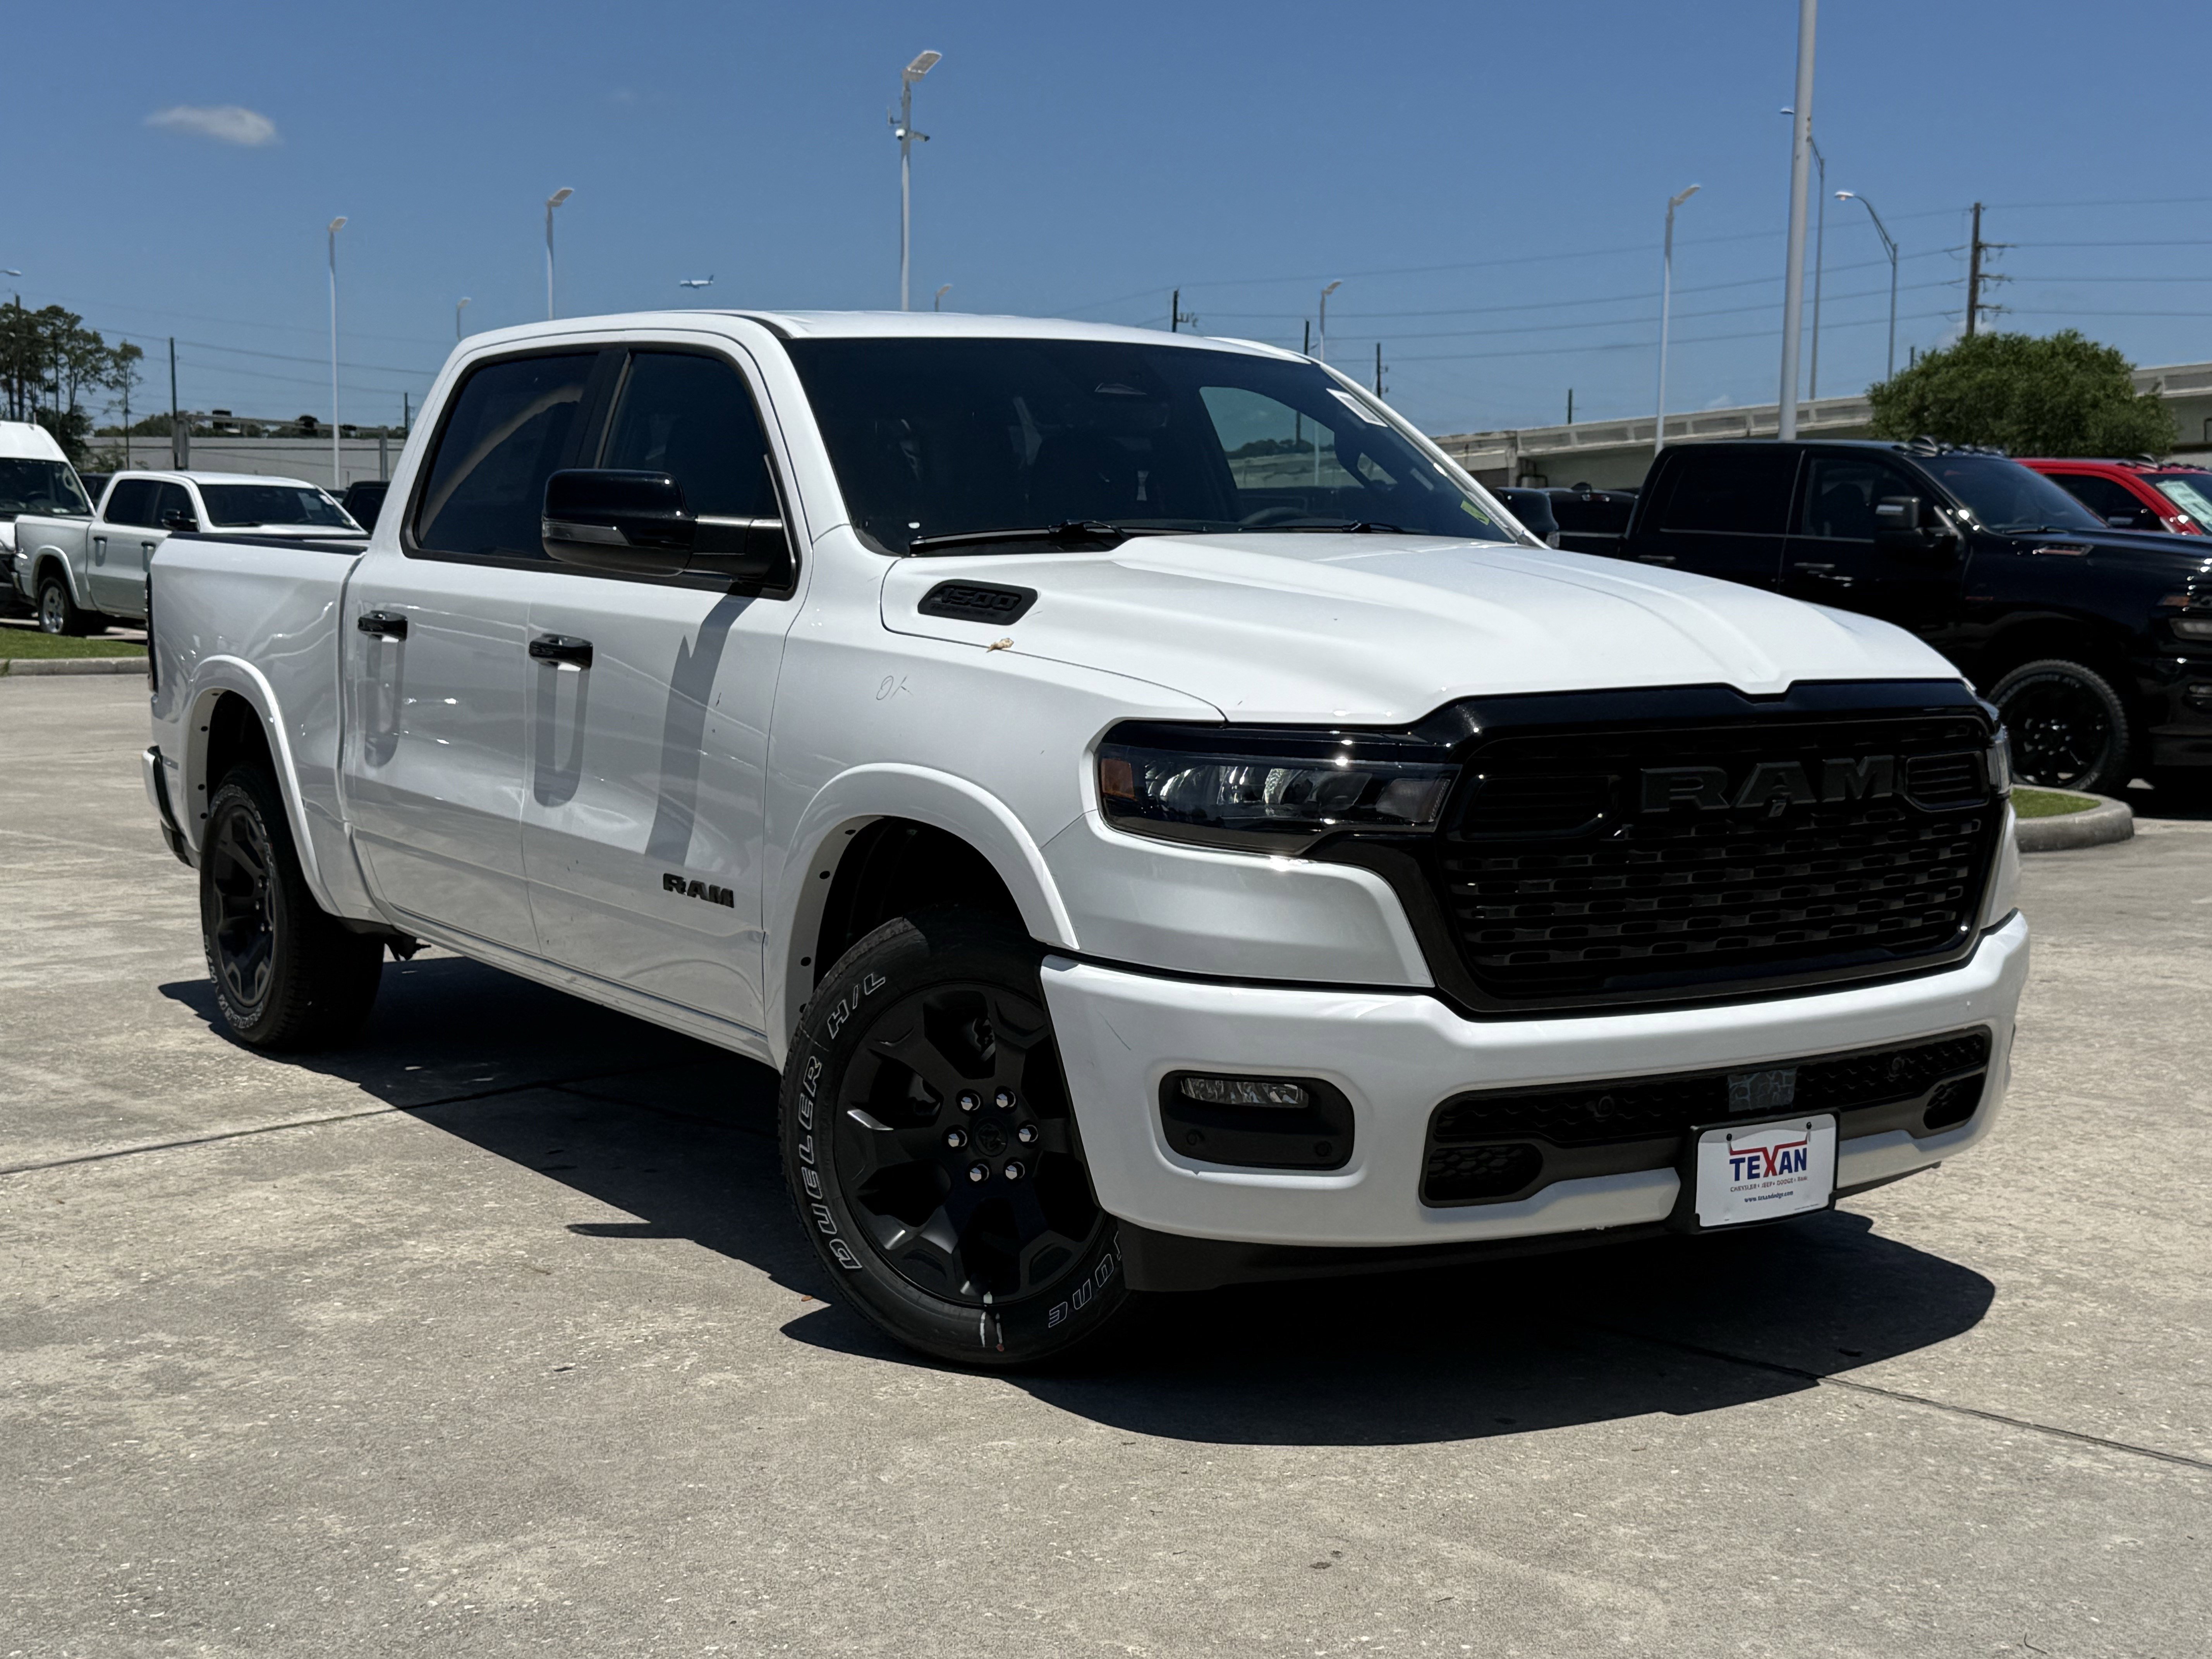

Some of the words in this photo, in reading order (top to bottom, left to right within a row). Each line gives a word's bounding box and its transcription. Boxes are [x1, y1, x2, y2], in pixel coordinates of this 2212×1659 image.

[941, 587, 1020, 611] 1500
[1640, 755, 1894, 813] RAM
[663, 873, 734, 908] RAM
[827, 972, 886, 1039] H/L
[799, 1055, 862, 1269] DUELER
[1729, 1144, 1807, 1182] TEXAN
